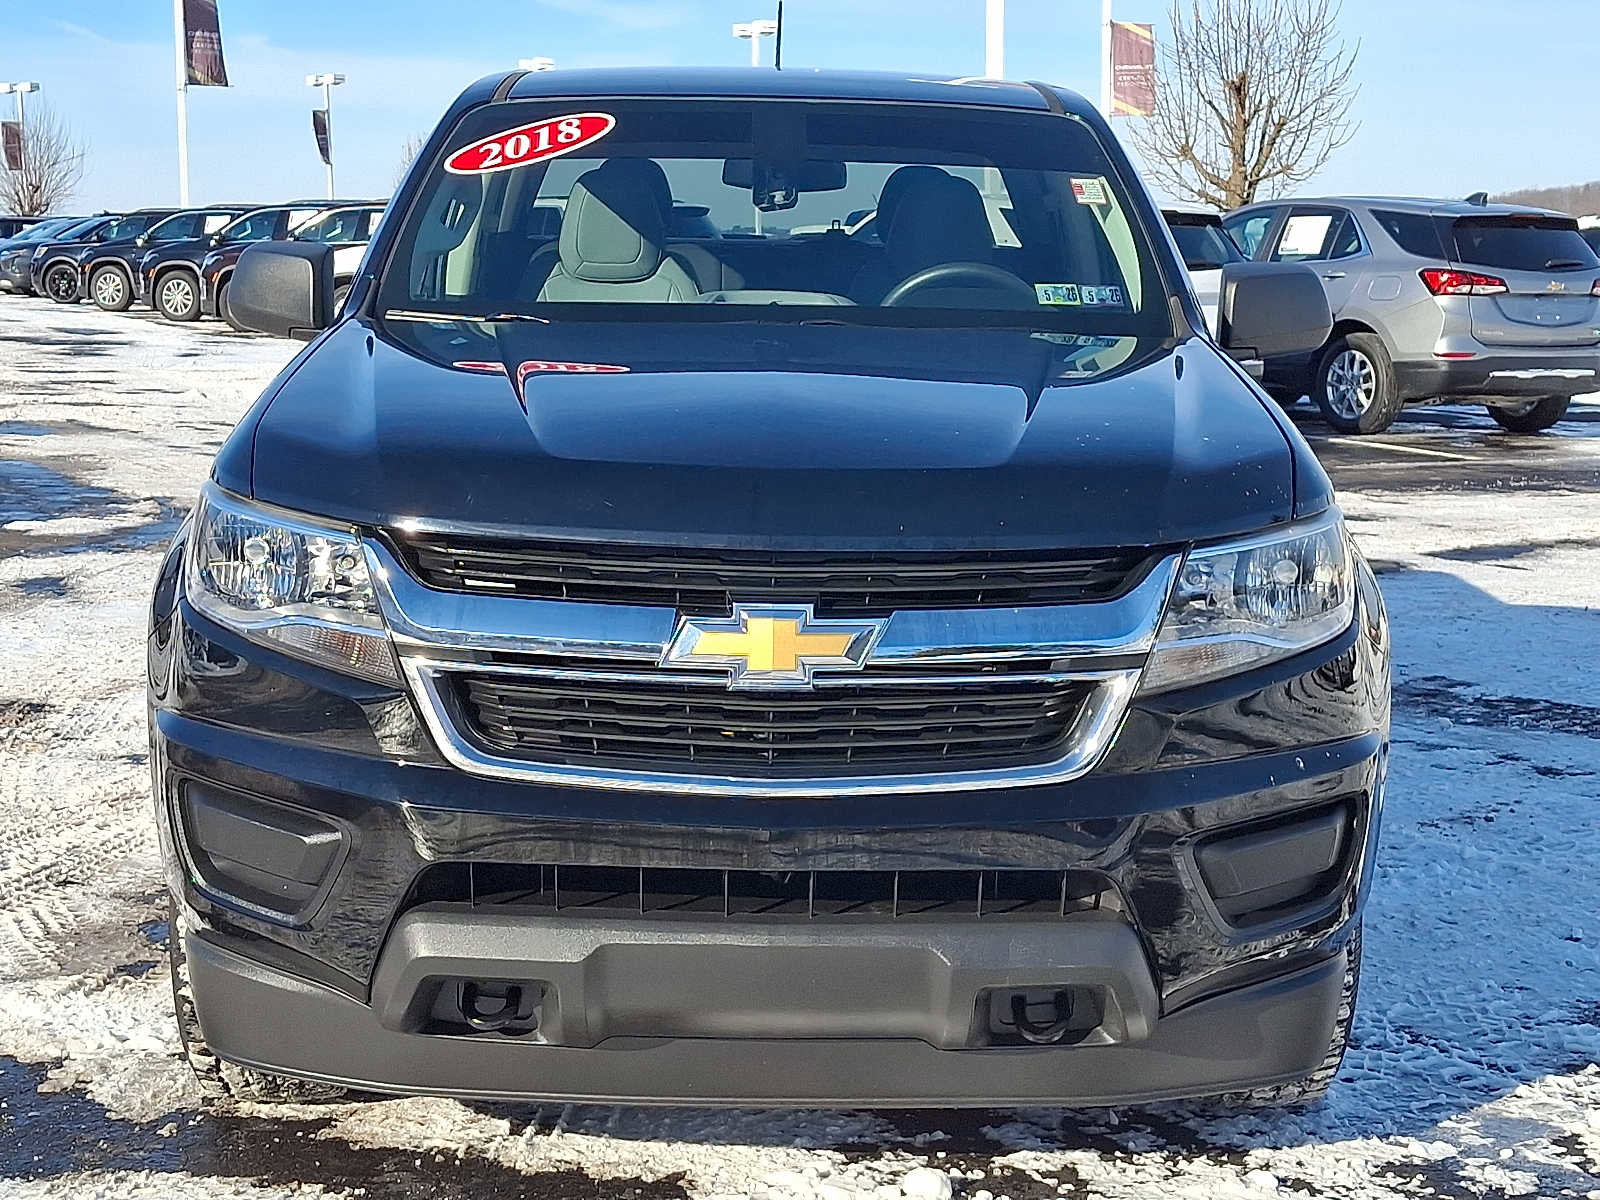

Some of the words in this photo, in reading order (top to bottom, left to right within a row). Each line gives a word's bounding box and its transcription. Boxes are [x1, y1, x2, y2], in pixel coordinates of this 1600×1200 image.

[478, 118, 582, 169] 2018
[1044, 289, 1052, 302] 5
[1065, 286, 1078, 302] 26
[1087, 290, 1095, 303] 5
[1109, 288, 1121, 303] 26
